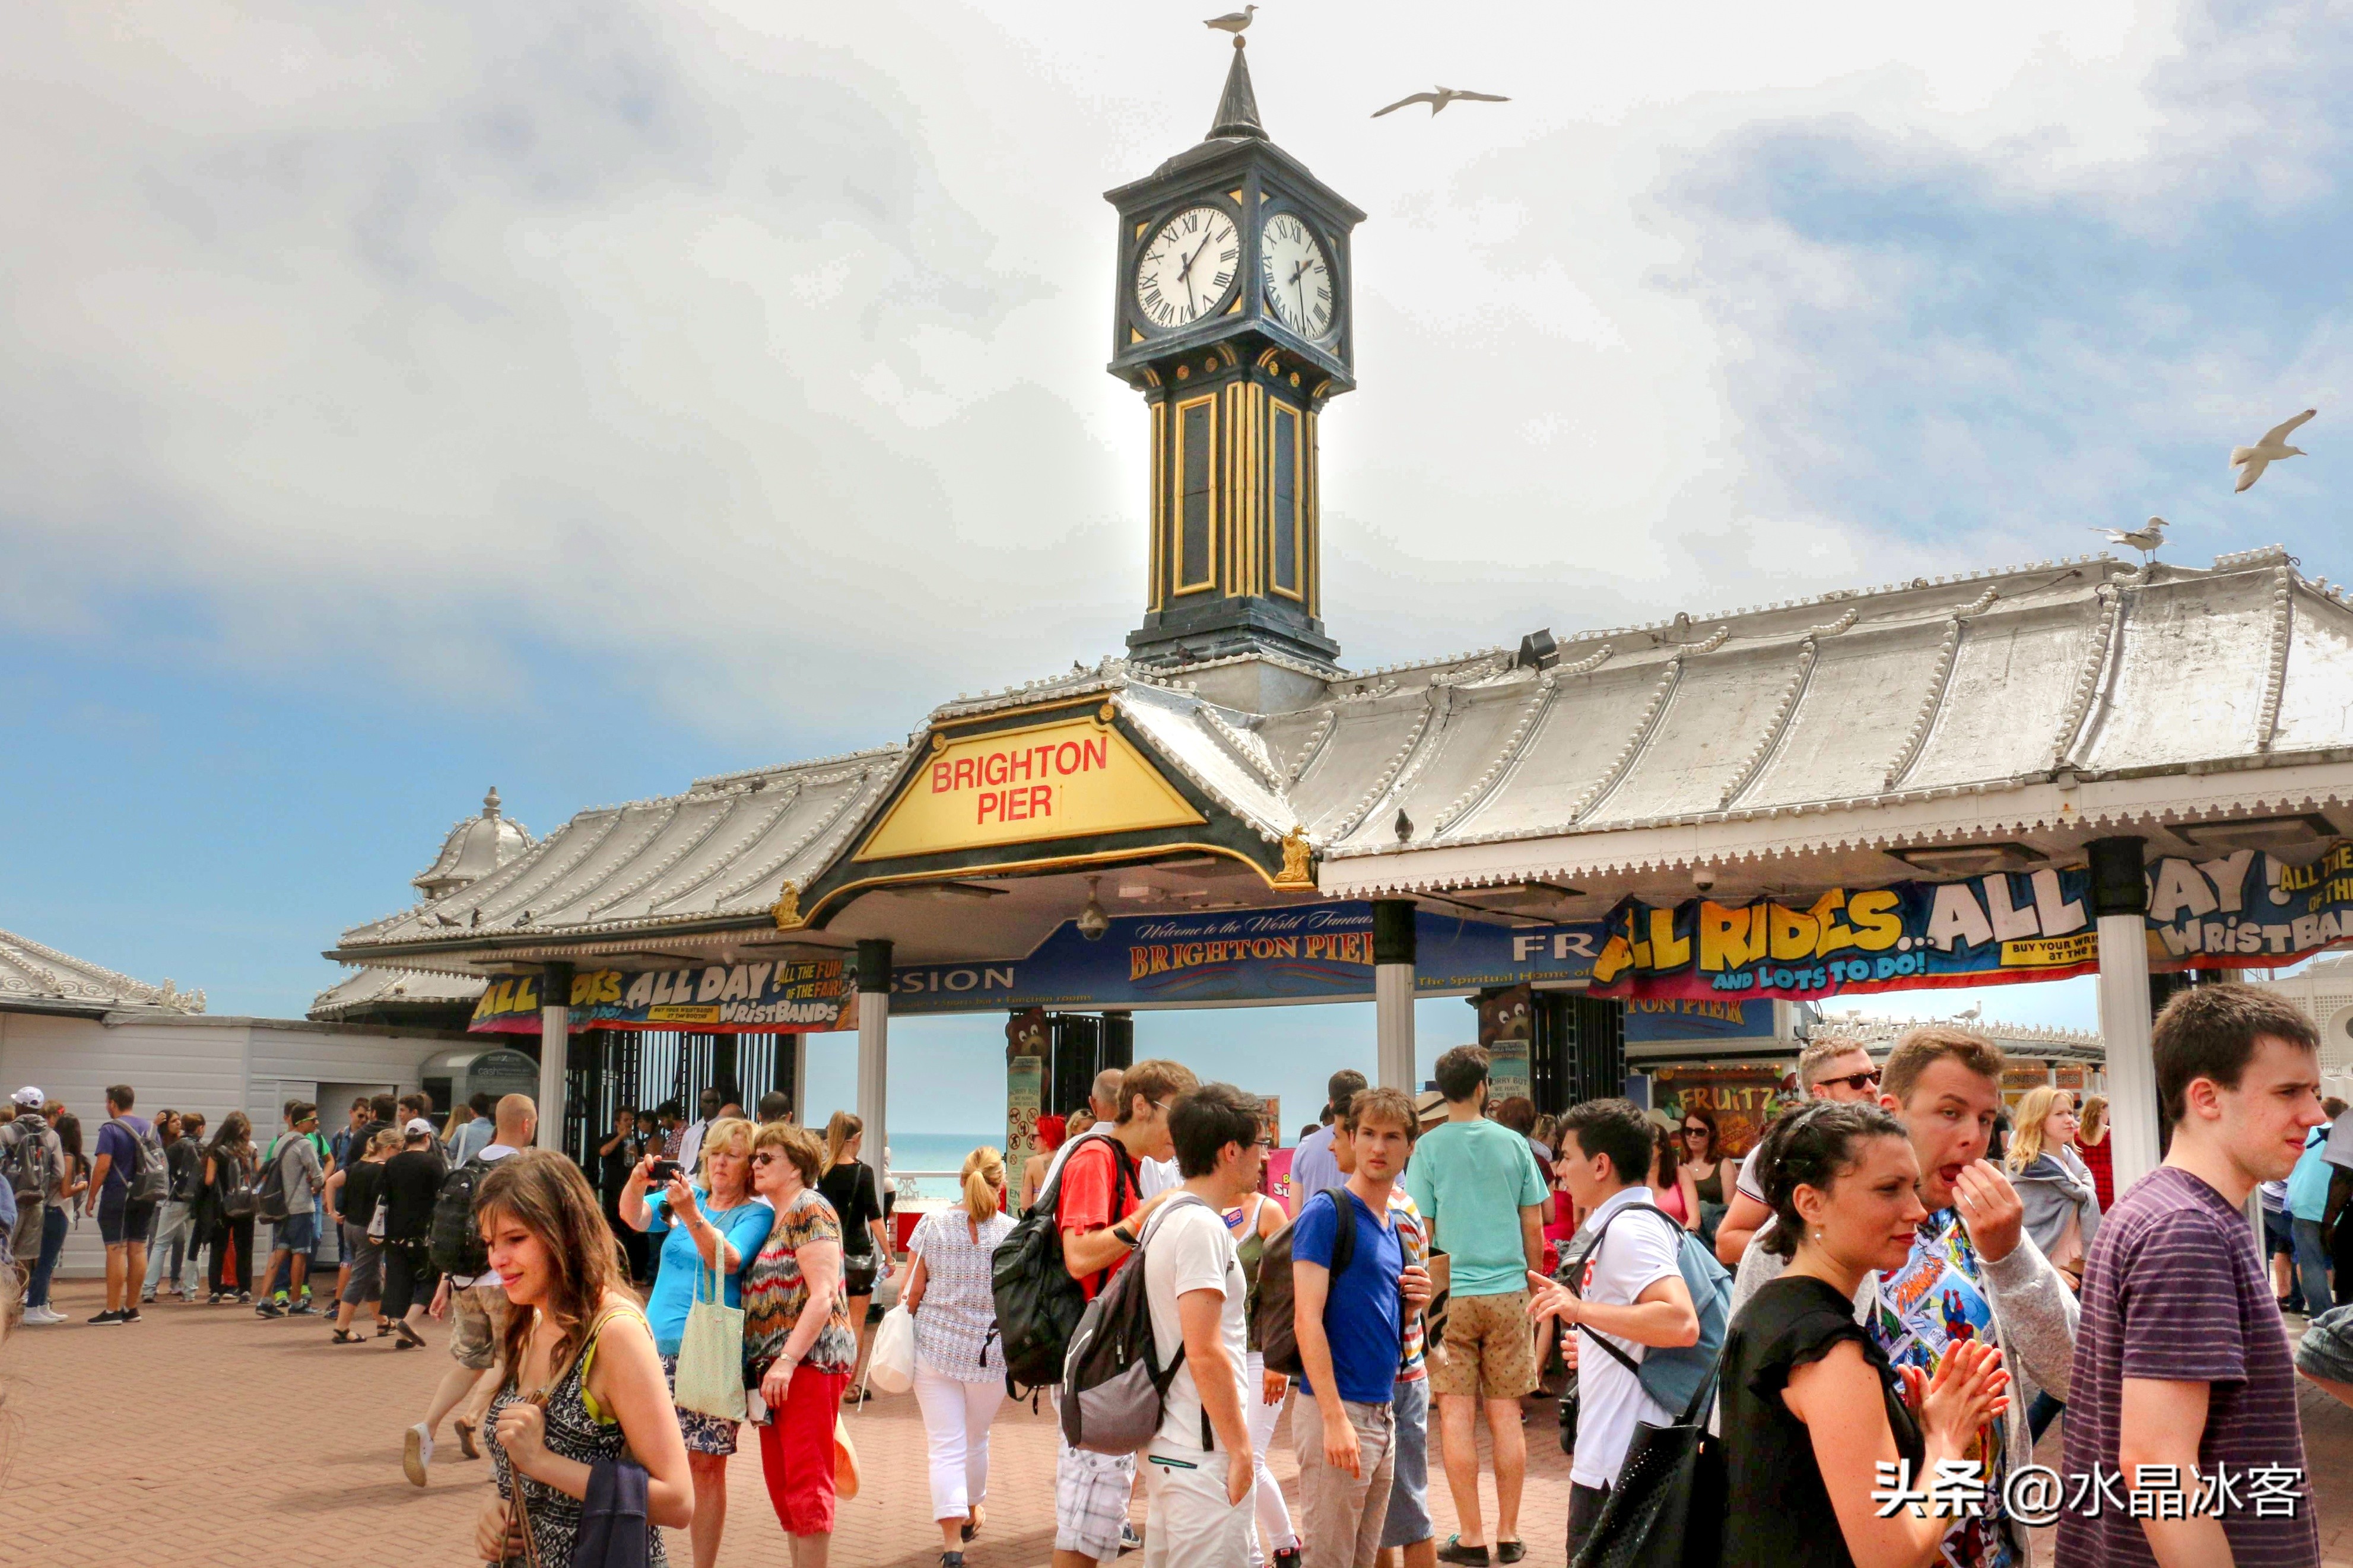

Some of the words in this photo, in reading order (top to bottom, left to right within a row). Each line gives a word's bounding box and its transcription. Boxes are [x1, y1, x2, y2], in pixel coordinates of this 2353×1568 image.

[932, 736, 1107, 794] BRIGHTON
[977, 784, 1053, 825] PIER
[2279, 863, 2319, 892] ALL
[1592, 907, 1691, 983] ALL
[1926, 869, 2087, 951] ALL
[2144, 849, 2291, 921] AY!
[2308, 893, 2323, 912] OF
[1135, 921, 1199, 940] Welcome
[1202, 924, 1217, 936] to
[1219, 920, 1241, 934] the
[1244, 914, 1306, 932] World
[1308, 911, 1373, 930] Famous
[1129, 936, 1300, 982] BRIGHTON
[2012, 943, 2036, 953] BUY
[2040, 941, 2071, 951] YOUR
[778, 966, 795, 985] ALL
[798, 964, 814, 979] THE
[816, 960, 842, 979] FUN
[1418, 977, 1445, 987] The
[1450, 972, 1513, 986] Spiritual
[1519, 970, 1568, 981] Home
[1574, 967, 1592, 977] of
[1711, 969, 1754, 990] AND
[1760, 966, 1827, 990] LOTS
[1830, 959, 1871, 982] TO
[1876, 952, 1926, 979] DO!
[472, 977, 537, 1020] ALL
[626, 967, 692, 1009] ALL
[697, 960, 787, 1003] DAY!
[786, 987, 797, 1000] OF
[796, 983, 814, 999] THE
[814, 979, 843, 998] FAIR!
[1006, 995, 1053, 1005] Function
[1056, 994, 1093, 1003] rooms
[1681, 998, 1745, 1026] PIER
[1491, 1076, 1511, 1085] ORRY
